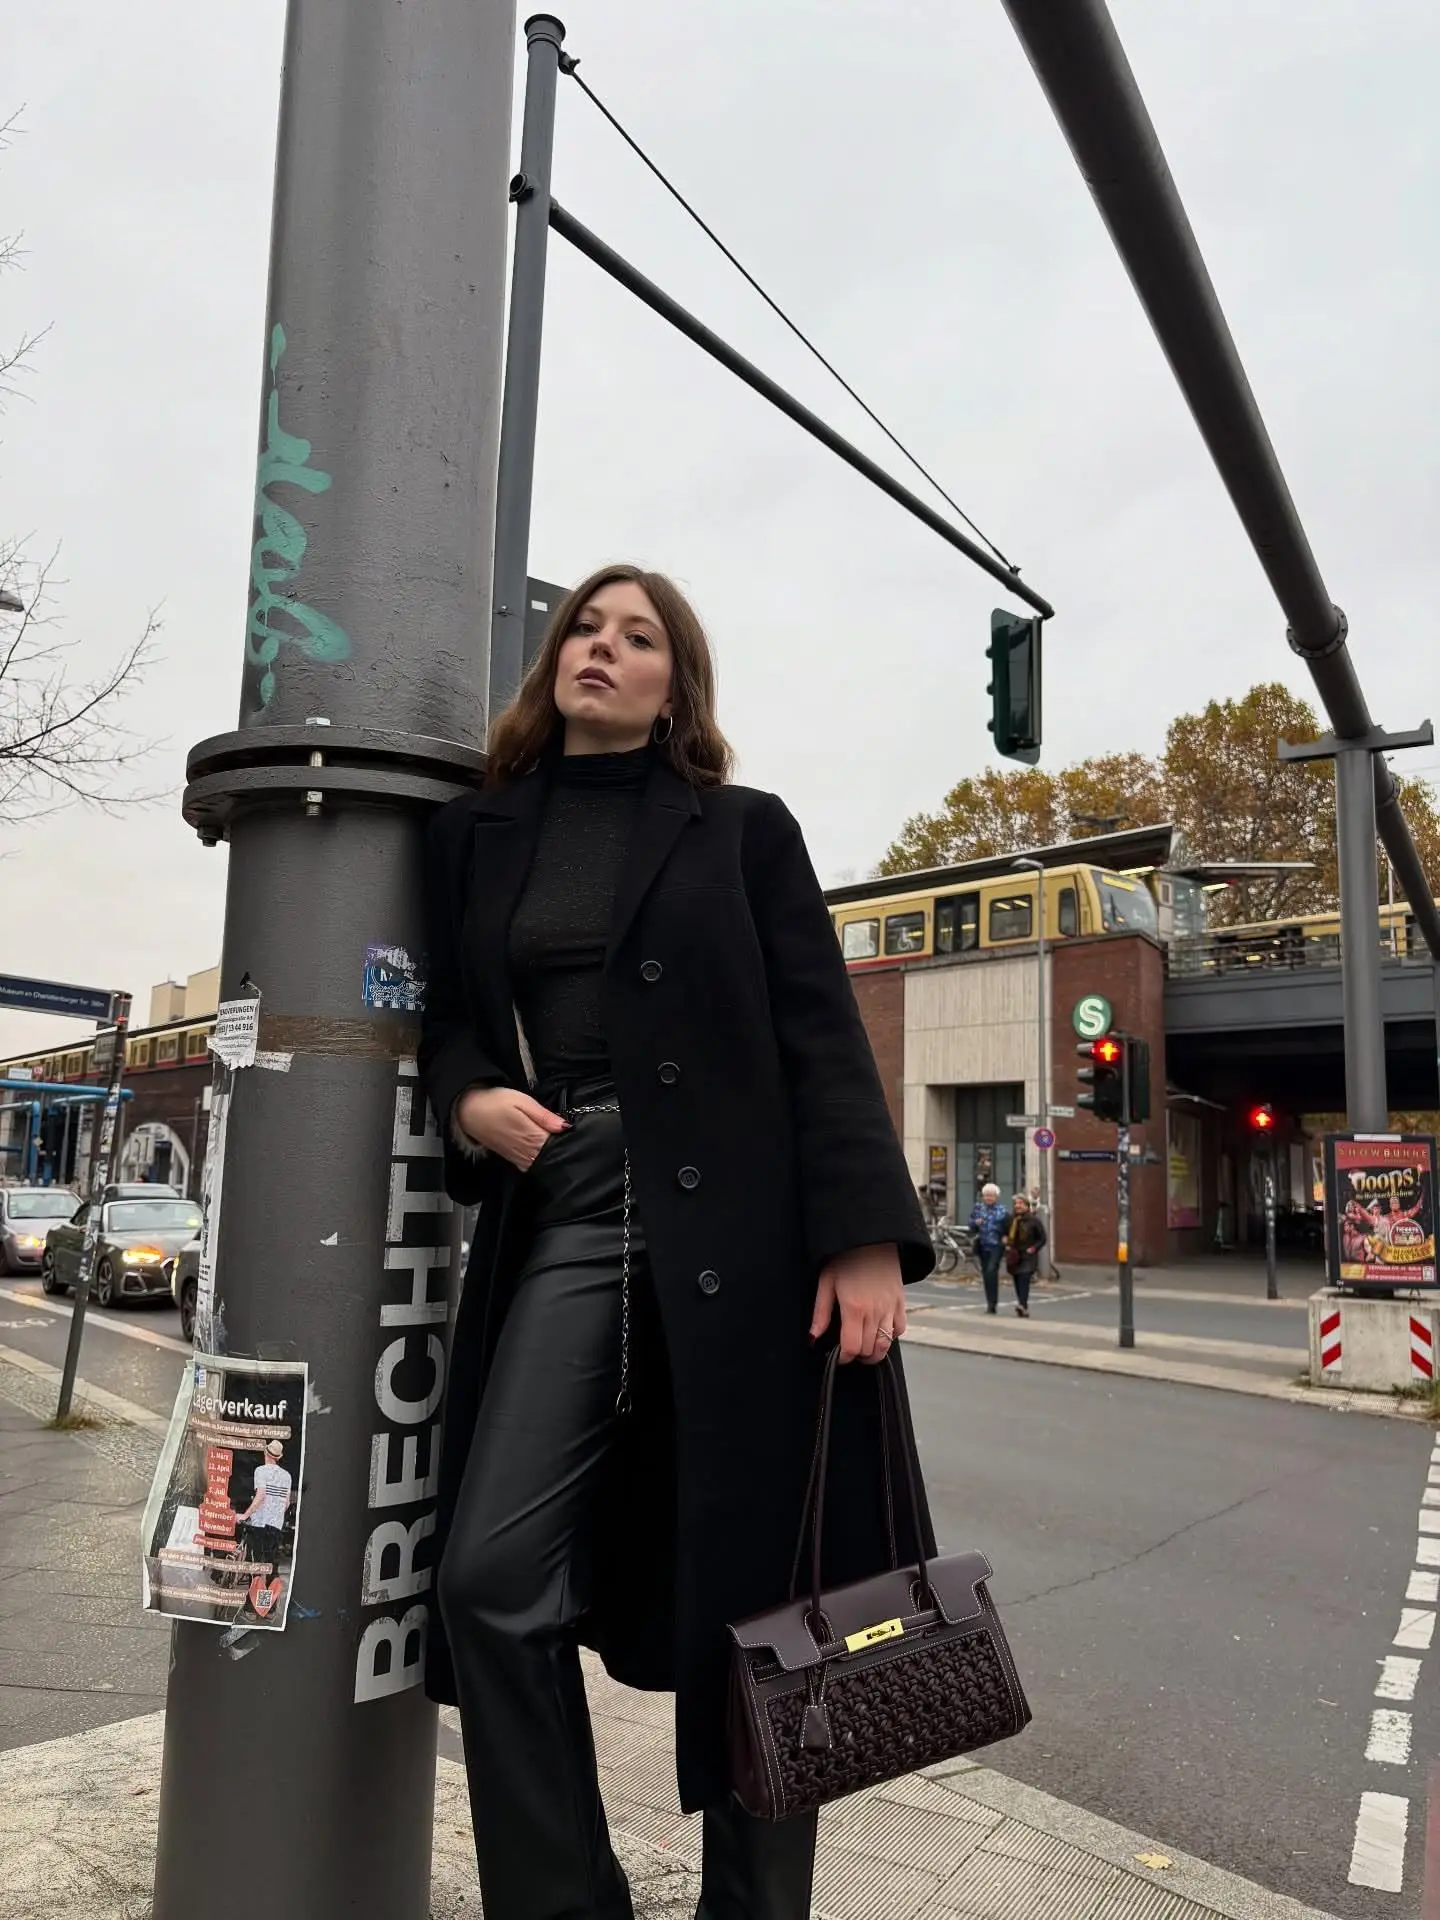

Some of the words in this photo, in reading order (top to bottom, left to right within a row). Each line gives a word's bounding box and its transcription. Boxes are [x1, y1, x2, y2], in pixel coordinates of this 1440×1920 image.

[1079, 998, 1105, 1036] S
[216, 1464, 230, 1472] April
[204, 1509, 233, 1520] September
[203, 1521, 233, 1531] November
